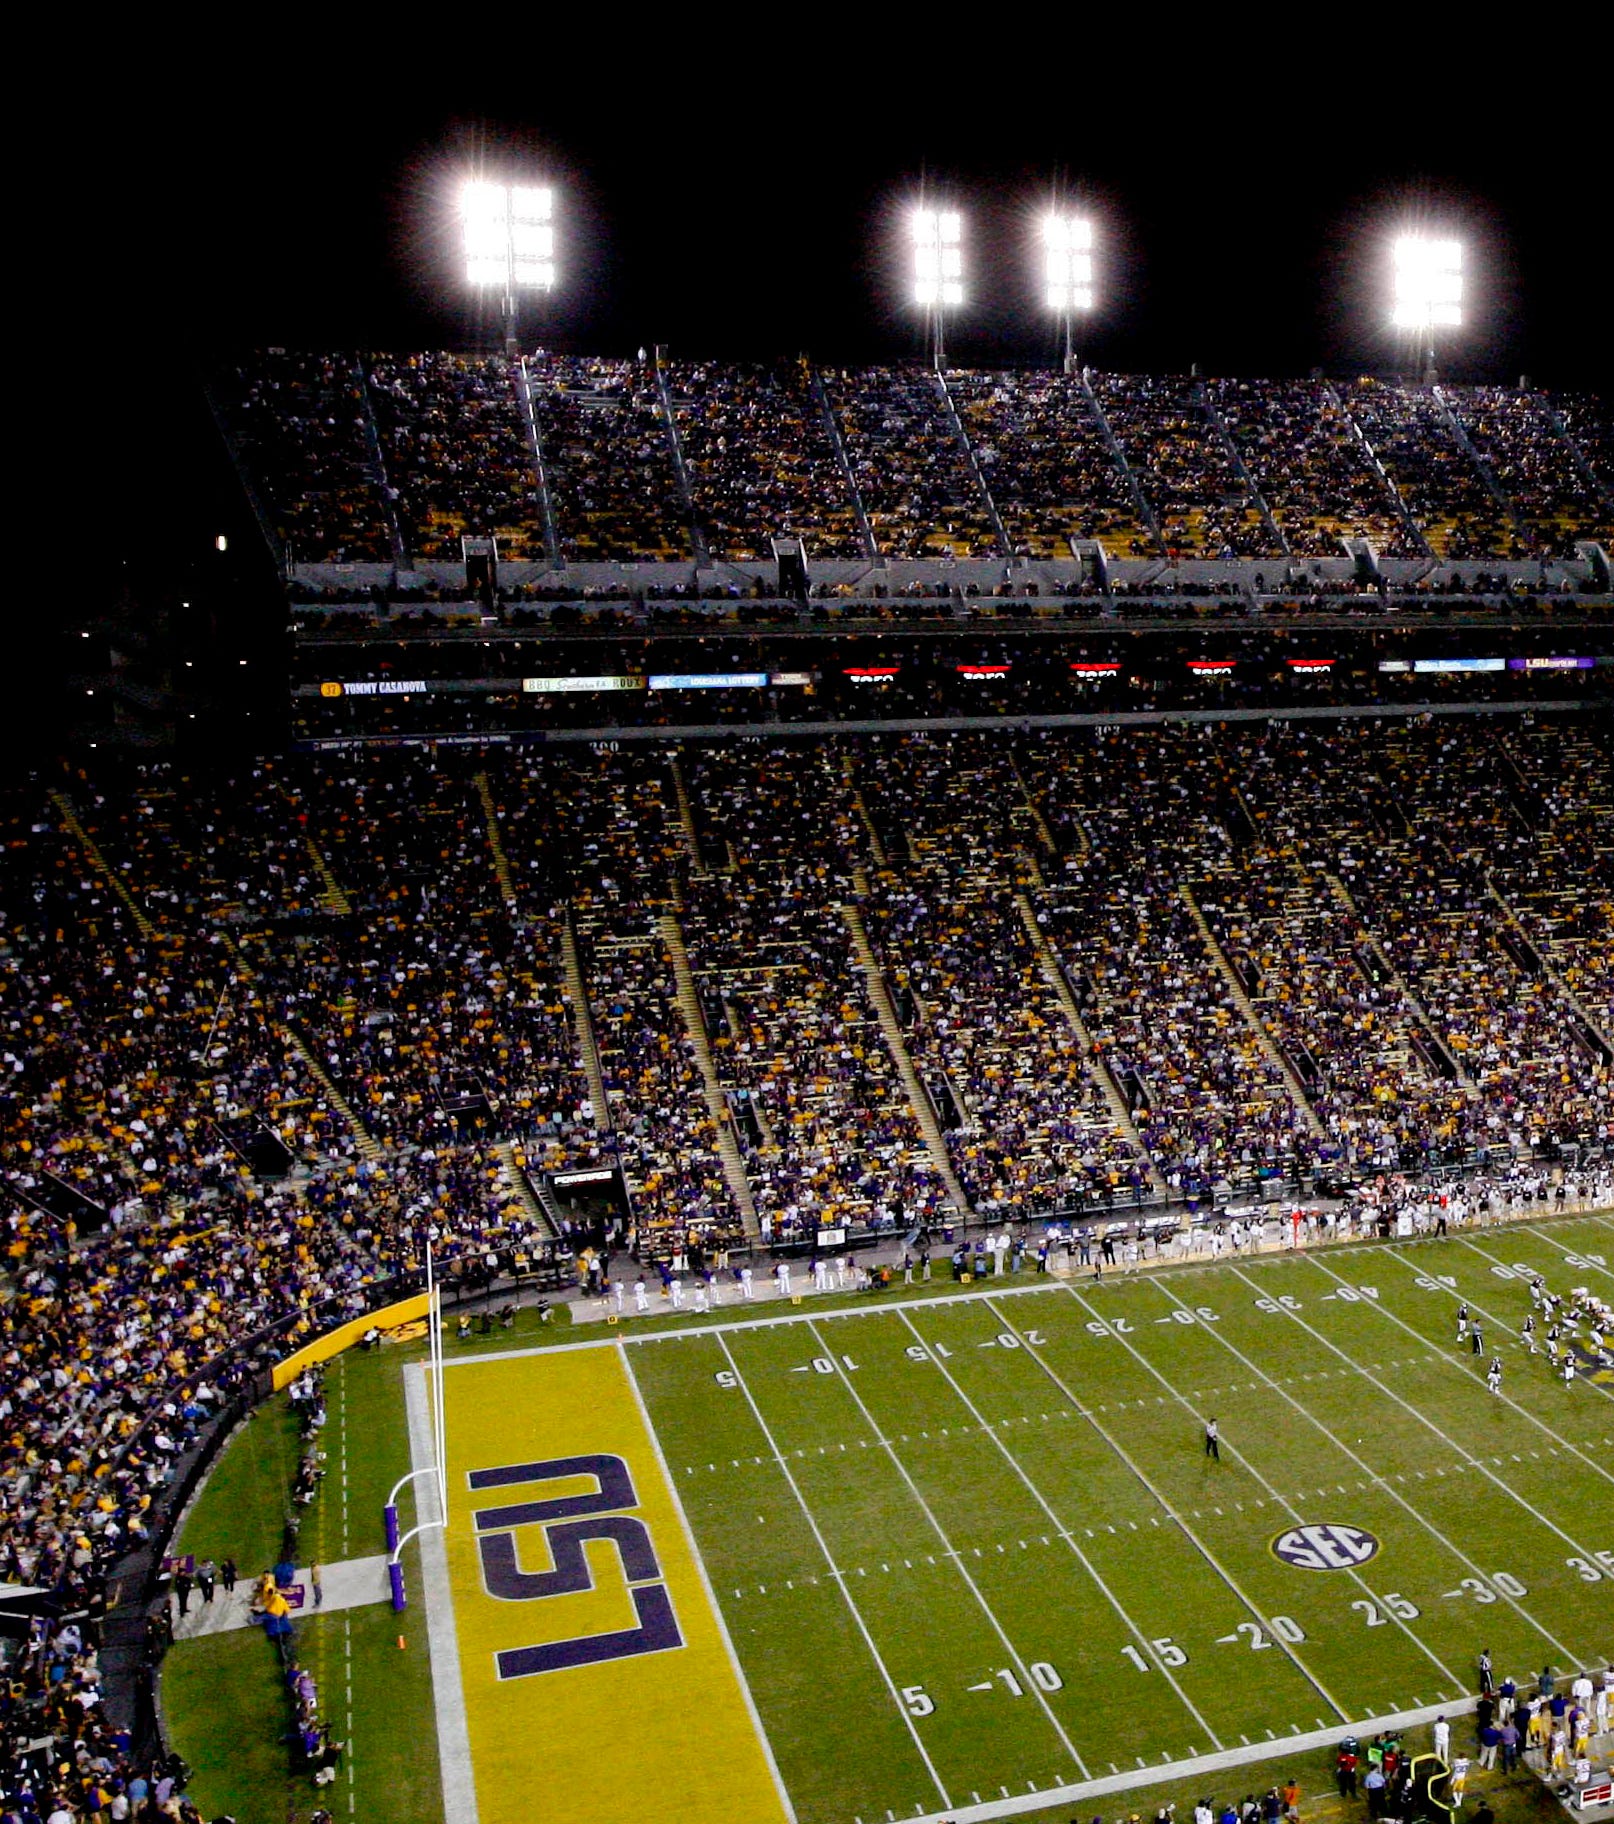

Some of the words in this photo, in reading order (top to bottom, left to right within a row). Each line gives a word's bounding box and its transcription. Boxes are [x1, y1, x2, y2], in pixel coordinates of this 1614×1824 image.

[343, 682, 377, 695] TOMMY
[379, 680, 427, 693] CASANOVA
[1489, 1263, 1539, 1280] 50
[1564, 1254, 1608, 1270] 45
[1414, 1274, 1459, 1292] 45
[1334, 1285, 1381, 1302] 40
[1255, 1295, 1303, 1314] 35
[1171, 1306, 1220, 1326] 30
[1085, 1317, 1136, 1337] 25
[997, 1329, 1047, 1350] 20
[906, 1342, 953, 1362] 15
[811, 1353, 860, 1374] 10
[714, 1369, 739, 1389] 5
[1278, 1523, 1375, 1570] SEC
[466, 1452, 688, 1682] LSU
[1461, 1572, 1529, 1604] 30
[1351, 1593, 1421, 1628] 25
[1237, 1615, 1307, 1651] 20
[1120, 1637, 1190, 1673] 15
[995, 1662, 1065, 1697] 10
[901, 1685, 937, 1716] 5
